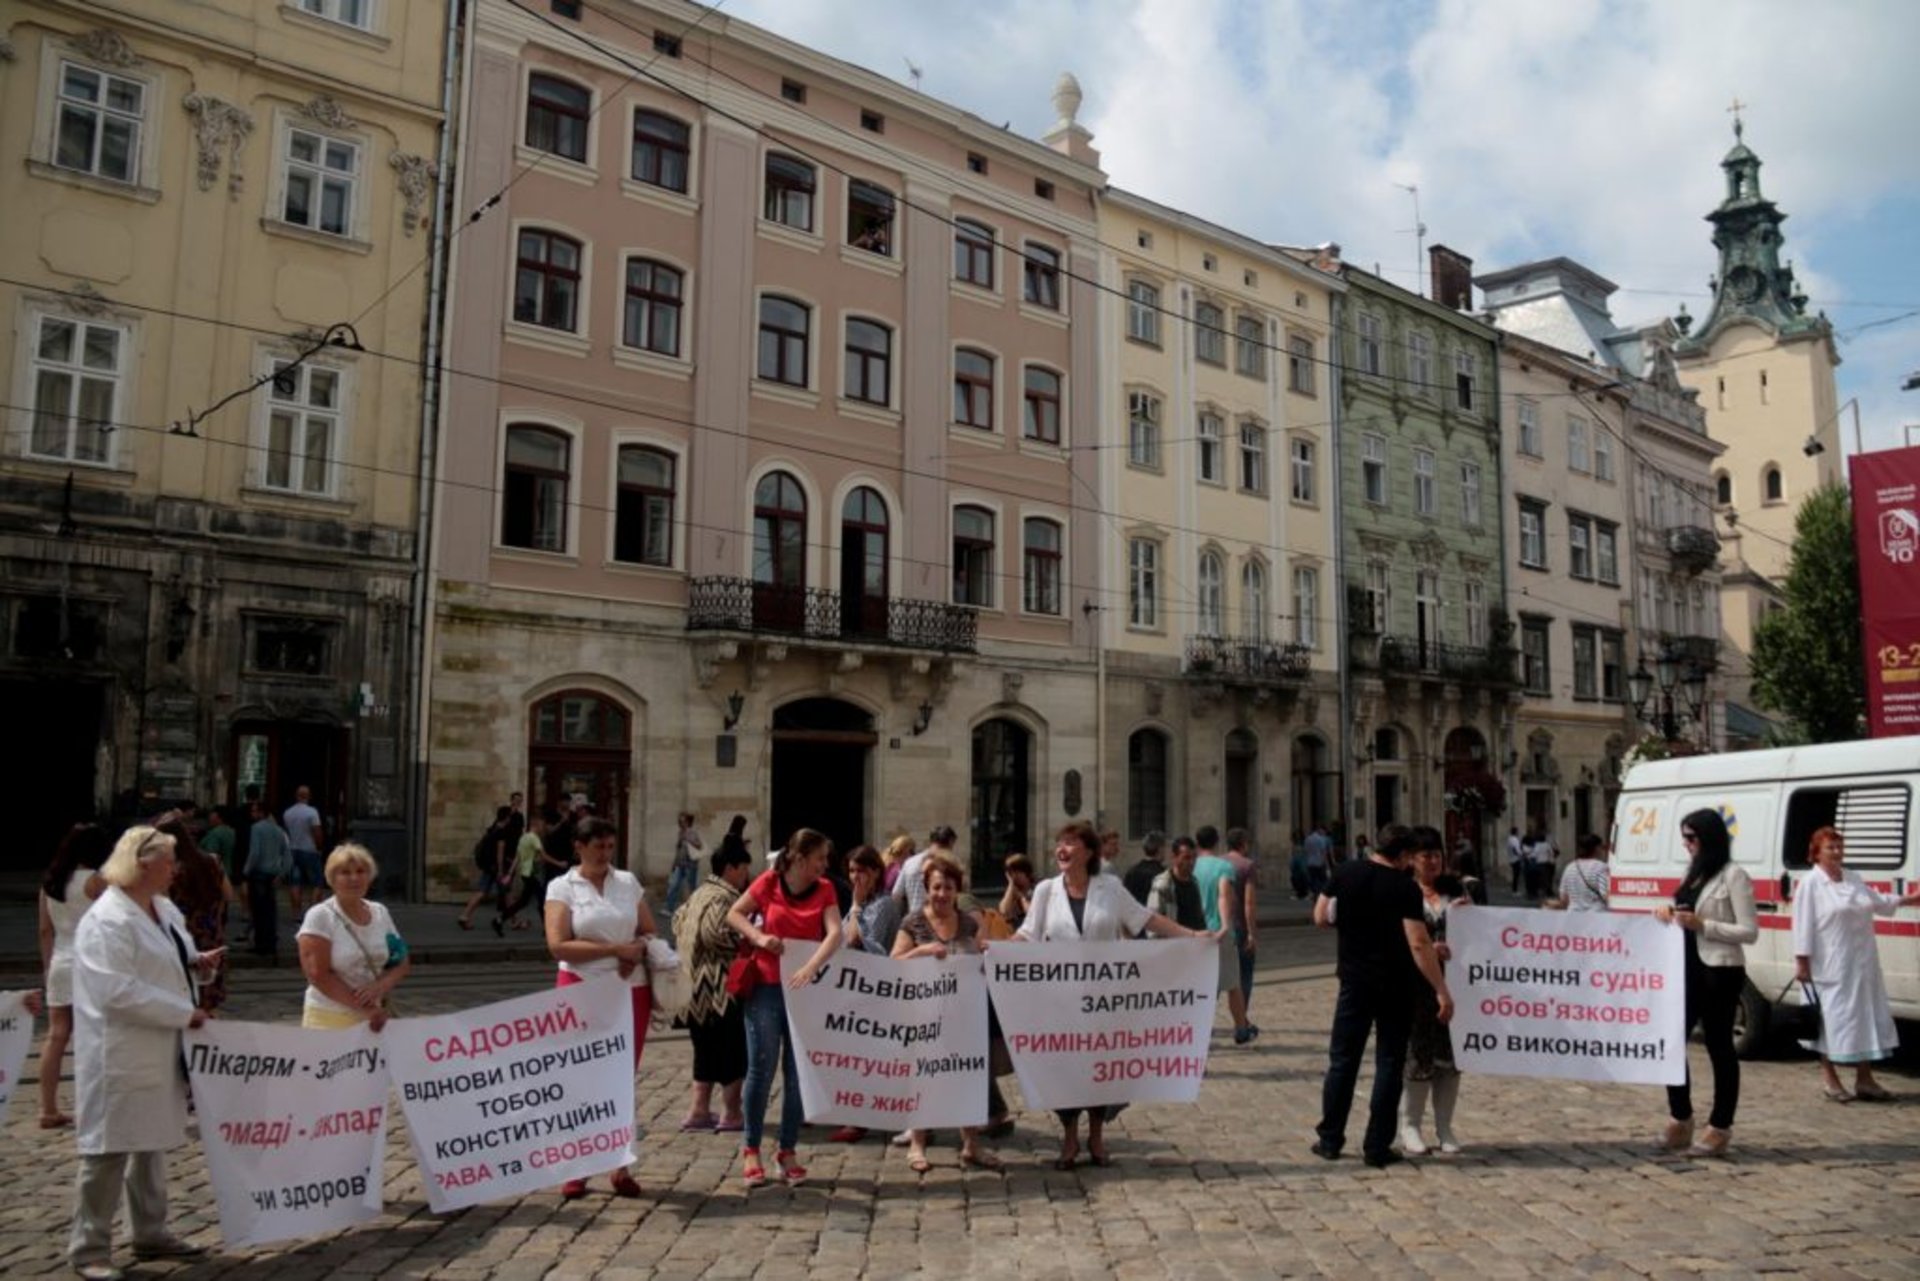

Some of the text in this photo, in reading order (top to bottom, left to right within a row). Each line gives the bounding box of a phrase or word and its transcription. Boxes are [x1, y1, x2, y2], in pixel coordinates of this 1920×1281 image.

[1887, 548, 1914, 564] 10
[1629, 806, 1657, 835] 24
[1500, 926, 1630, 958] Садовий,
[835, 966, 958, 1001] Львівській
[995, 962, 1141, 982] НЕВИПЛАТА
[1468, 960, 1665, 994] рішення судів
[1480, 994, 1650, 1025] обов'язкове
[424, 1002, 588, 1064] САДОВИЙ,
[825, 1011, 942, 1047] міськраді
[1463, 1032, 1666, 1061] до виконання!
[807, 1049, 986, 1079] ституція України
[404, 1069, 505, 1102] ВІДНОВИ
[477, 1083, 565, 1119] ТОБОЮ
[835, 1090, 865, 1108] не
[435, 1099, 617, 1160] КОНСТИТУЦІЙНІ
[498, 1159, 524, 1178] та
